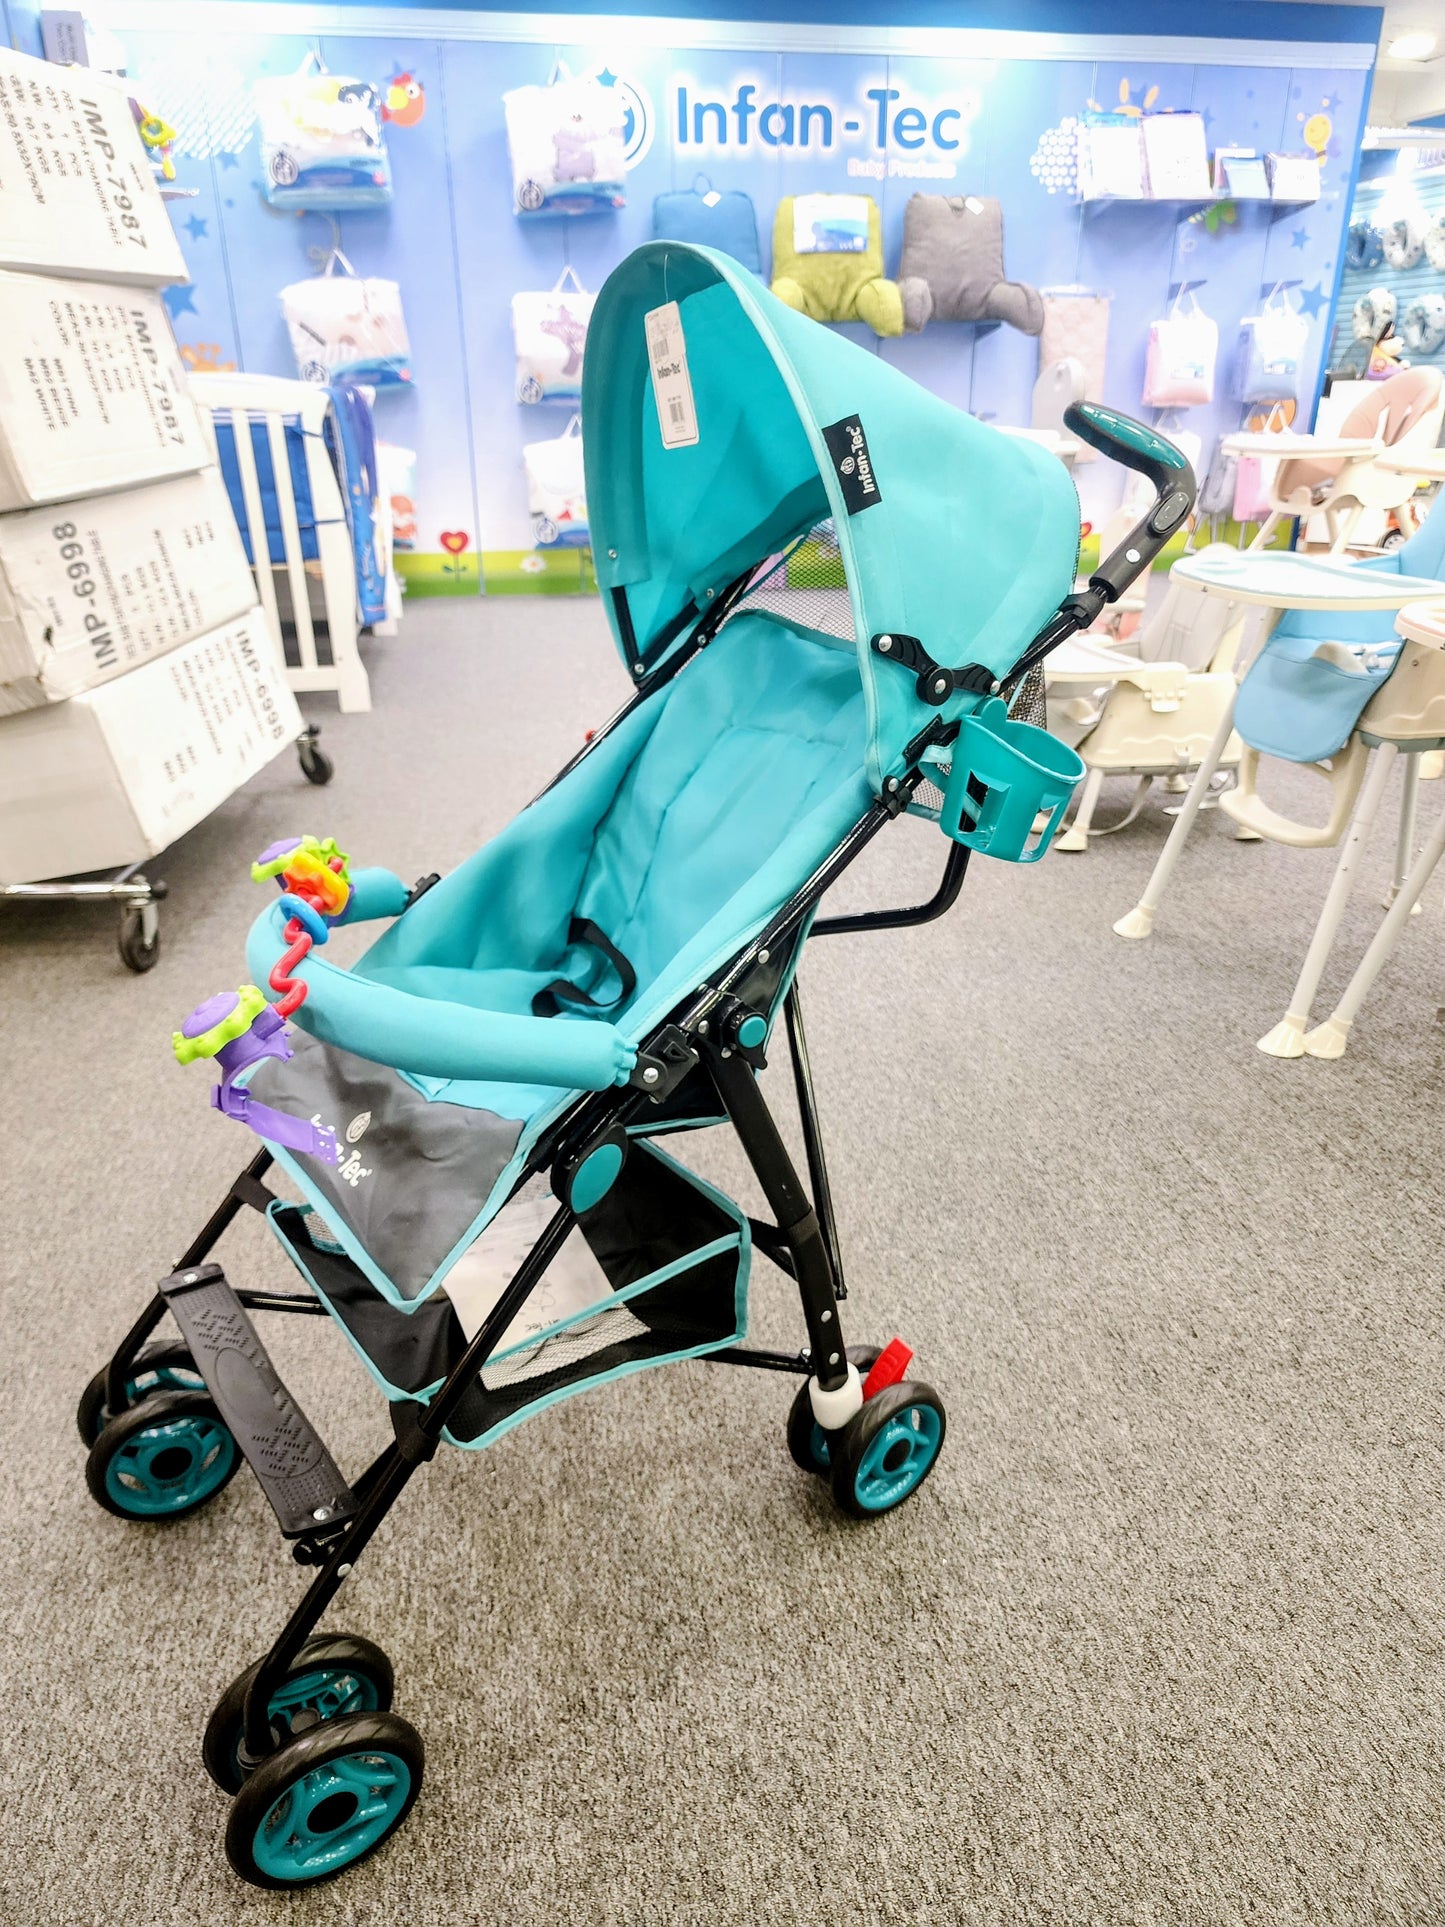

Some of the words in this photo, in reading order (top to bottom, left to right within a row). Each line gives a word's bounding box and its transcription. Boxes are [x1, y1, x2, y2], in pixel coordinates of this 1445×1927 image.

[79, 99, 148, 249] IMP-7987
[677, 85, 962, 150] Infan-Tec
[52, 521, 118, 669] IMP-6998
